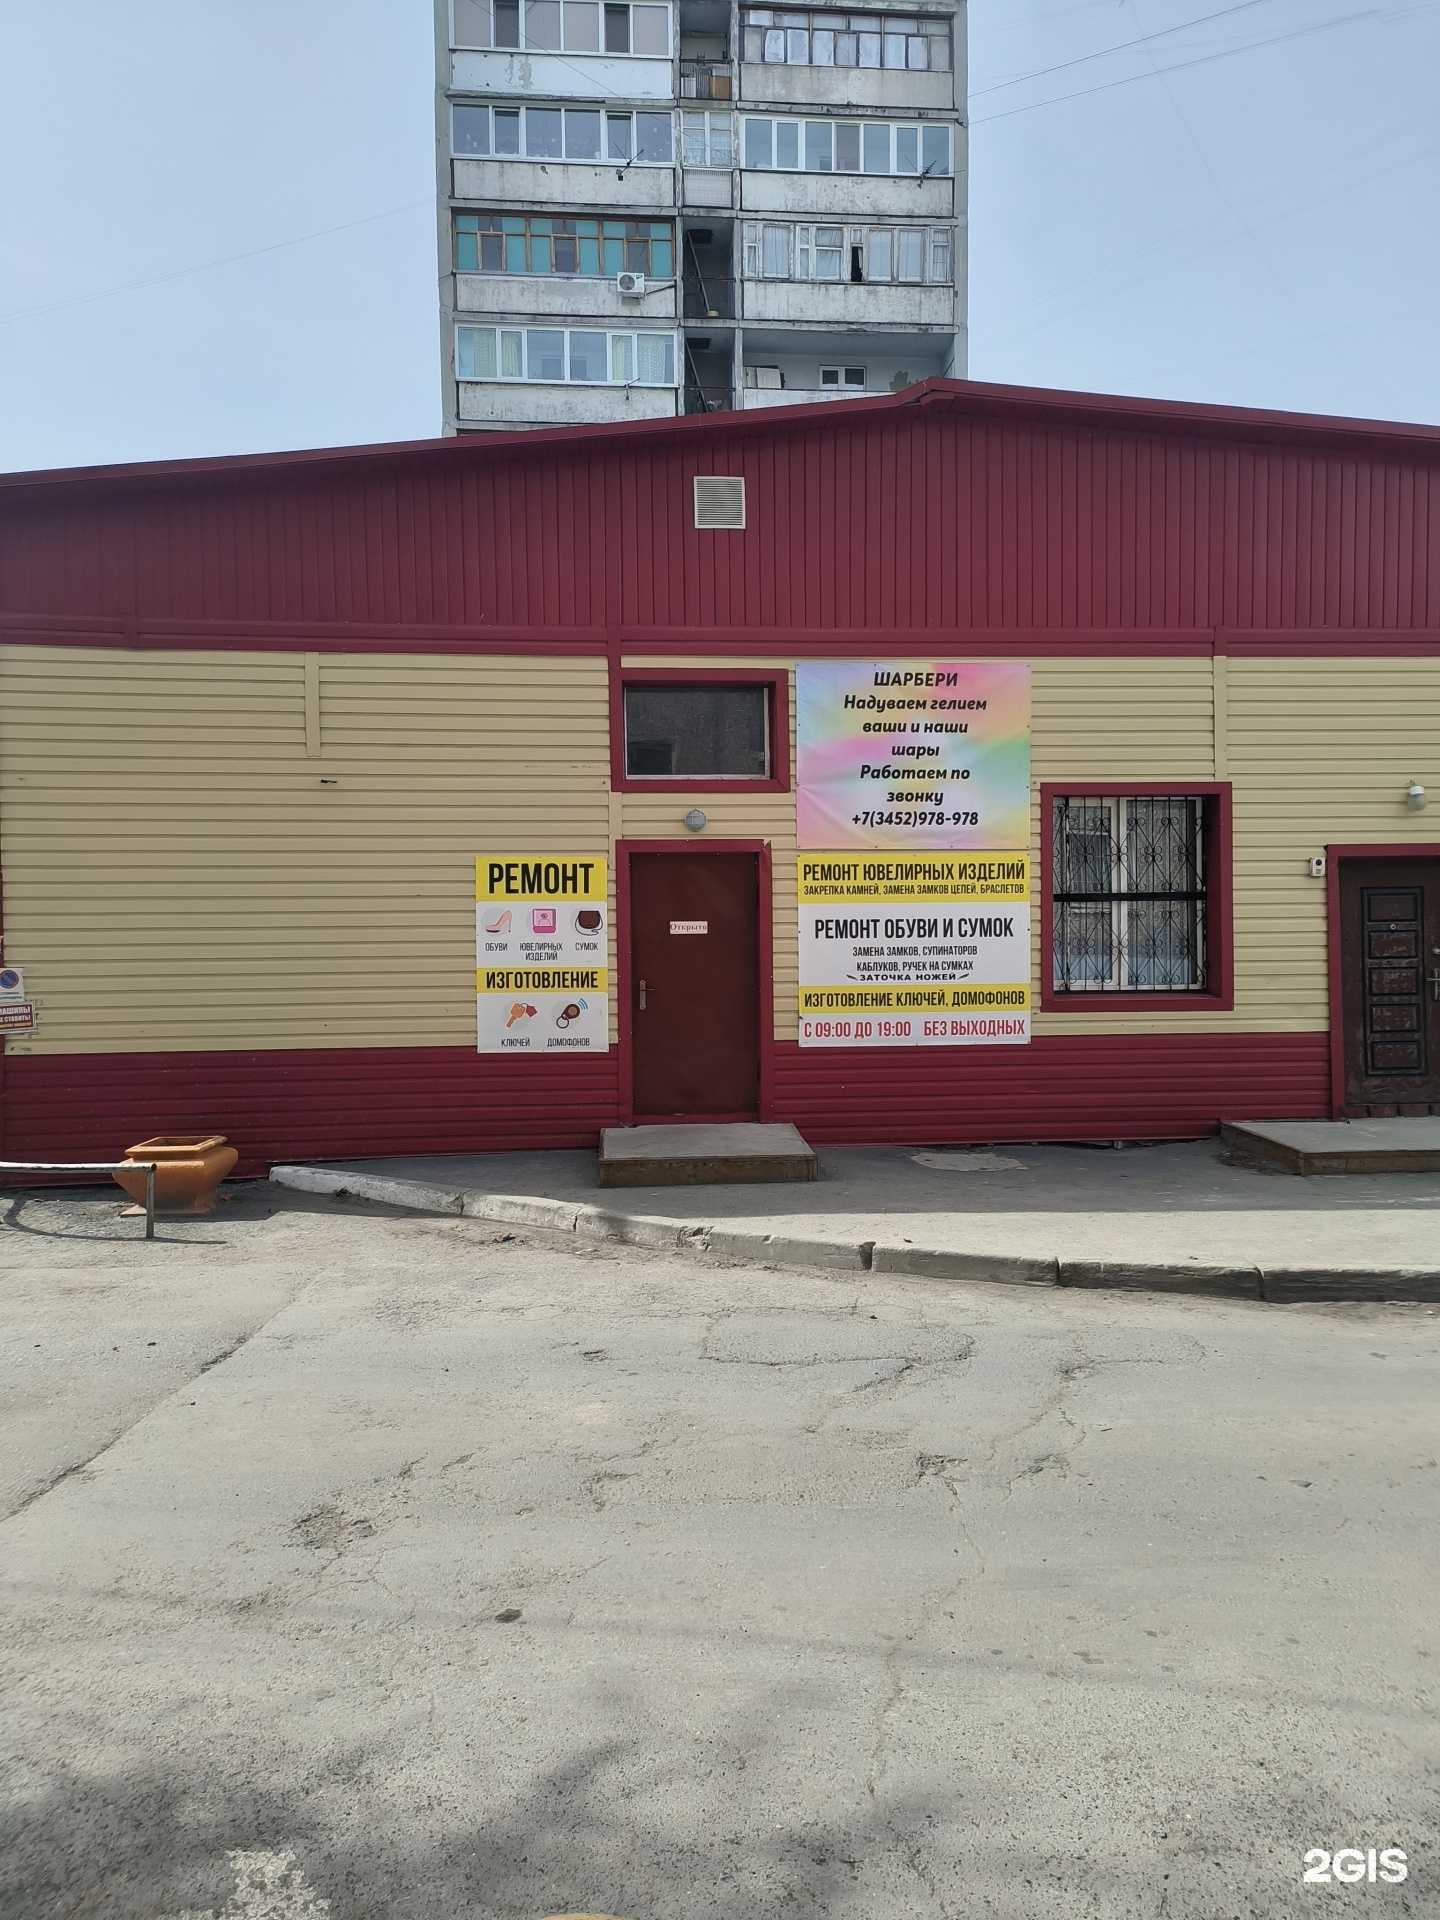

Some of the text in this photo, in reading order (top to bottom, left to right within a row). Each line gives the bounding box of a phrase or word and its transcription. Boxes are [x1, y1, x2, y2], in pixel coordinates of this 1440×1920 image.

[874, 672, 958, 687] ШАРБЕРИ
[844, 695, 987, 712] Надуваем гелием
[862, 722, 968, 734] ваши и наши
[891, 746, 939, 759] шары
[860, 765, 970, 779] Работаем по
[887, 792, 943, 805] звонку
[852, 812, 979, 828] +7(3452)978-978
[803, 859, 1025, 882] РЕМОНТ ЮВЕЛИРНЫХ ИЗДЕЛИЙ
[488, 863, 594, 894] РЕМОНТ
[804, 885, 845, 895] ЗАКРЕПКА
[883, 885, 915, 895] ЗАМЕНА
[917, 885, 949, 894] ЗАМКОВ
[980, 884, 1024, 894] БРАСЛЕТОВ
[670, 922, 707, 931] Открыто
[815, 918, 1014, 939] РЕМОНТ ОБУВИ И СУМОК
[485, 943, 508, 951] ОБУВИ
[520, 943, 563, 951] ЮВЕЛИРНЫХ
[853, 946, 977, 956] ЗАМЕНА ЗАМКОВ, СУПИНАТОРОВ
[525, 951, 558, 961] ИЗДЕЛИЙ
[857, 961, 973, 972] КАБЛУКОВ, РУЧЕК НА СУМКАХ
[486, 971, 598, 989] ИЗГОТОВЛЕНИЕ
[916, 973, 956, 981] НОЖЕЙ
[804, 990, 1025, 1007] ИЗГОТОВЛЕНИЕ КЛЮЧЕЙ, ДОМОФОНОВ
[804, 1022, 911, 1039] С 09:00 ДО 19:00
[924, 1020, 1025, 1036] БЕЗ ВЫХОДНЫХ
[501, 1037, 530, 1047] КЛЮЧЕЙ
[547, 1038, 590, 1047] ДОМОФОНОВ
